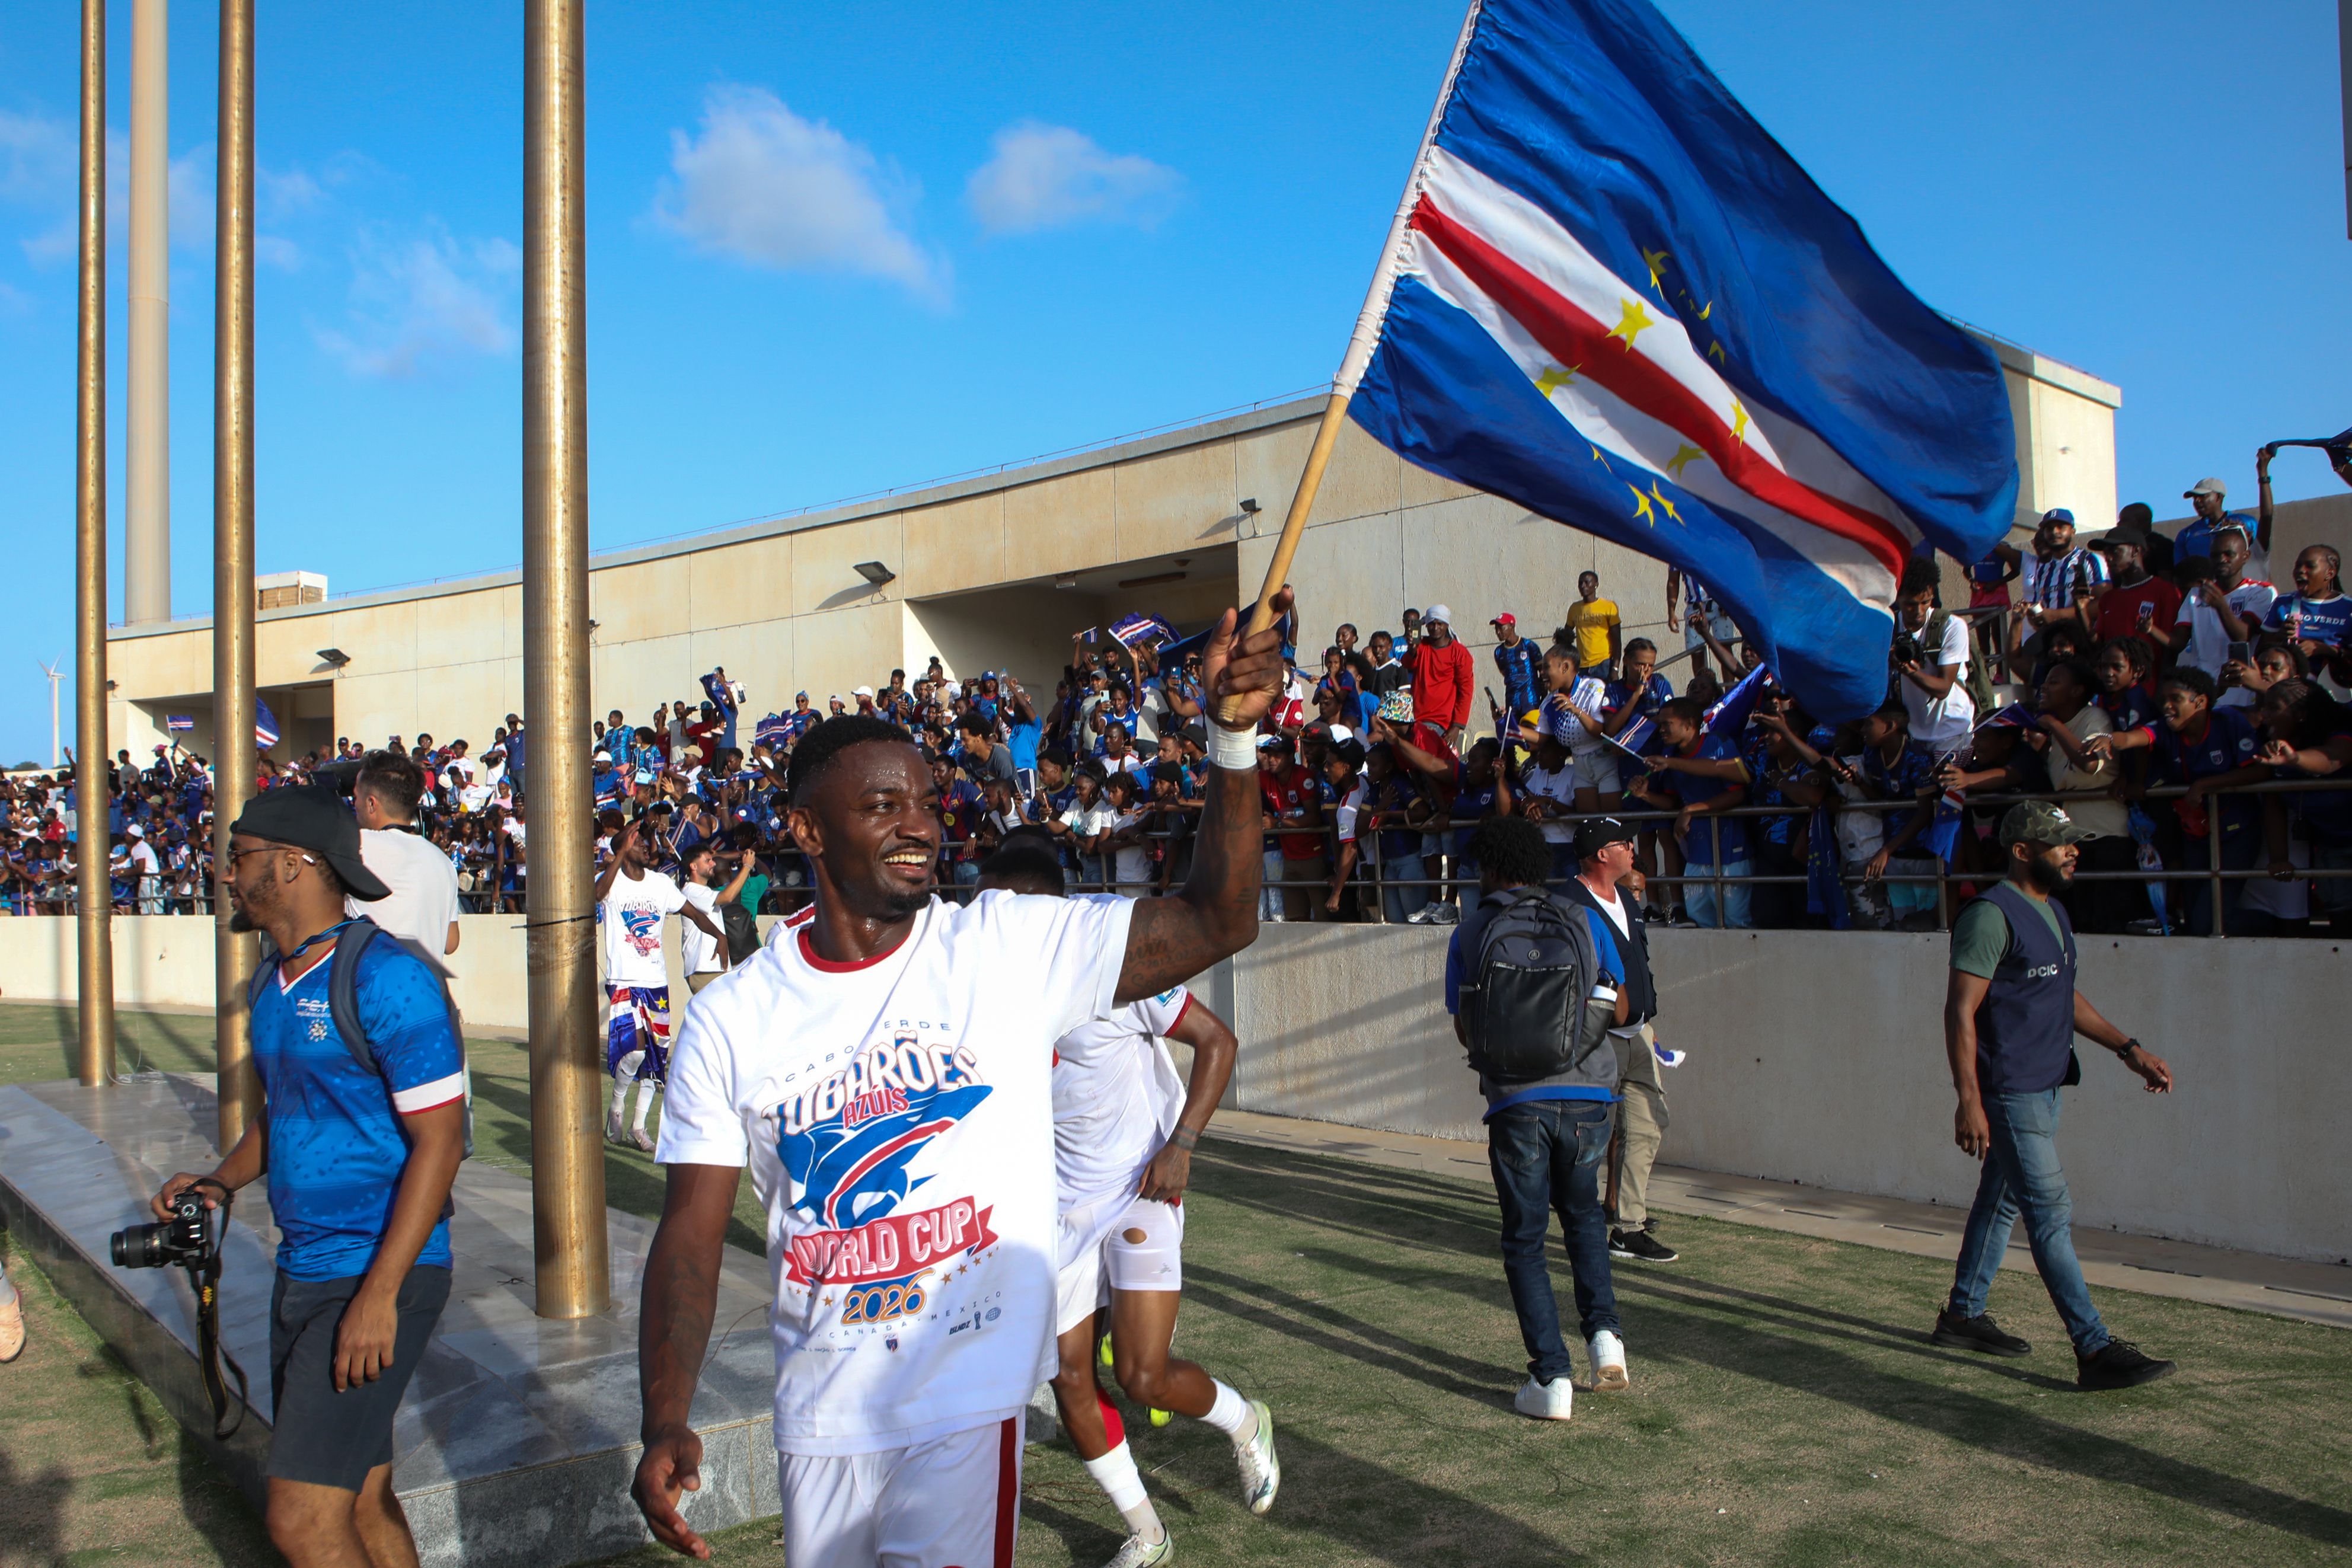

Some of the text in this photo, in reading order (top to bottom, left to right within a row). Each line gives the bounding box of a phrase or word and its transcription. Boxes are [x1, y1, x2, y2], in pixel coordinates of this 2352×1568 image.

[2284, 614, 2346, 625] CBO VERDE
[2027, 963, 2057, 978] DCIC
[785, 1019, 952, 1082] CABO ERDE
[761, 1030, 984, 1145] TUBARÕES
[842, 1084, 910, 1129] AZÚIS
[793, 1202, 972, 1279] WORLD CUP
[829, 1291, 1001, 1339] CANADA MEXICO
[841, 1267, 936, 1326] 2026
